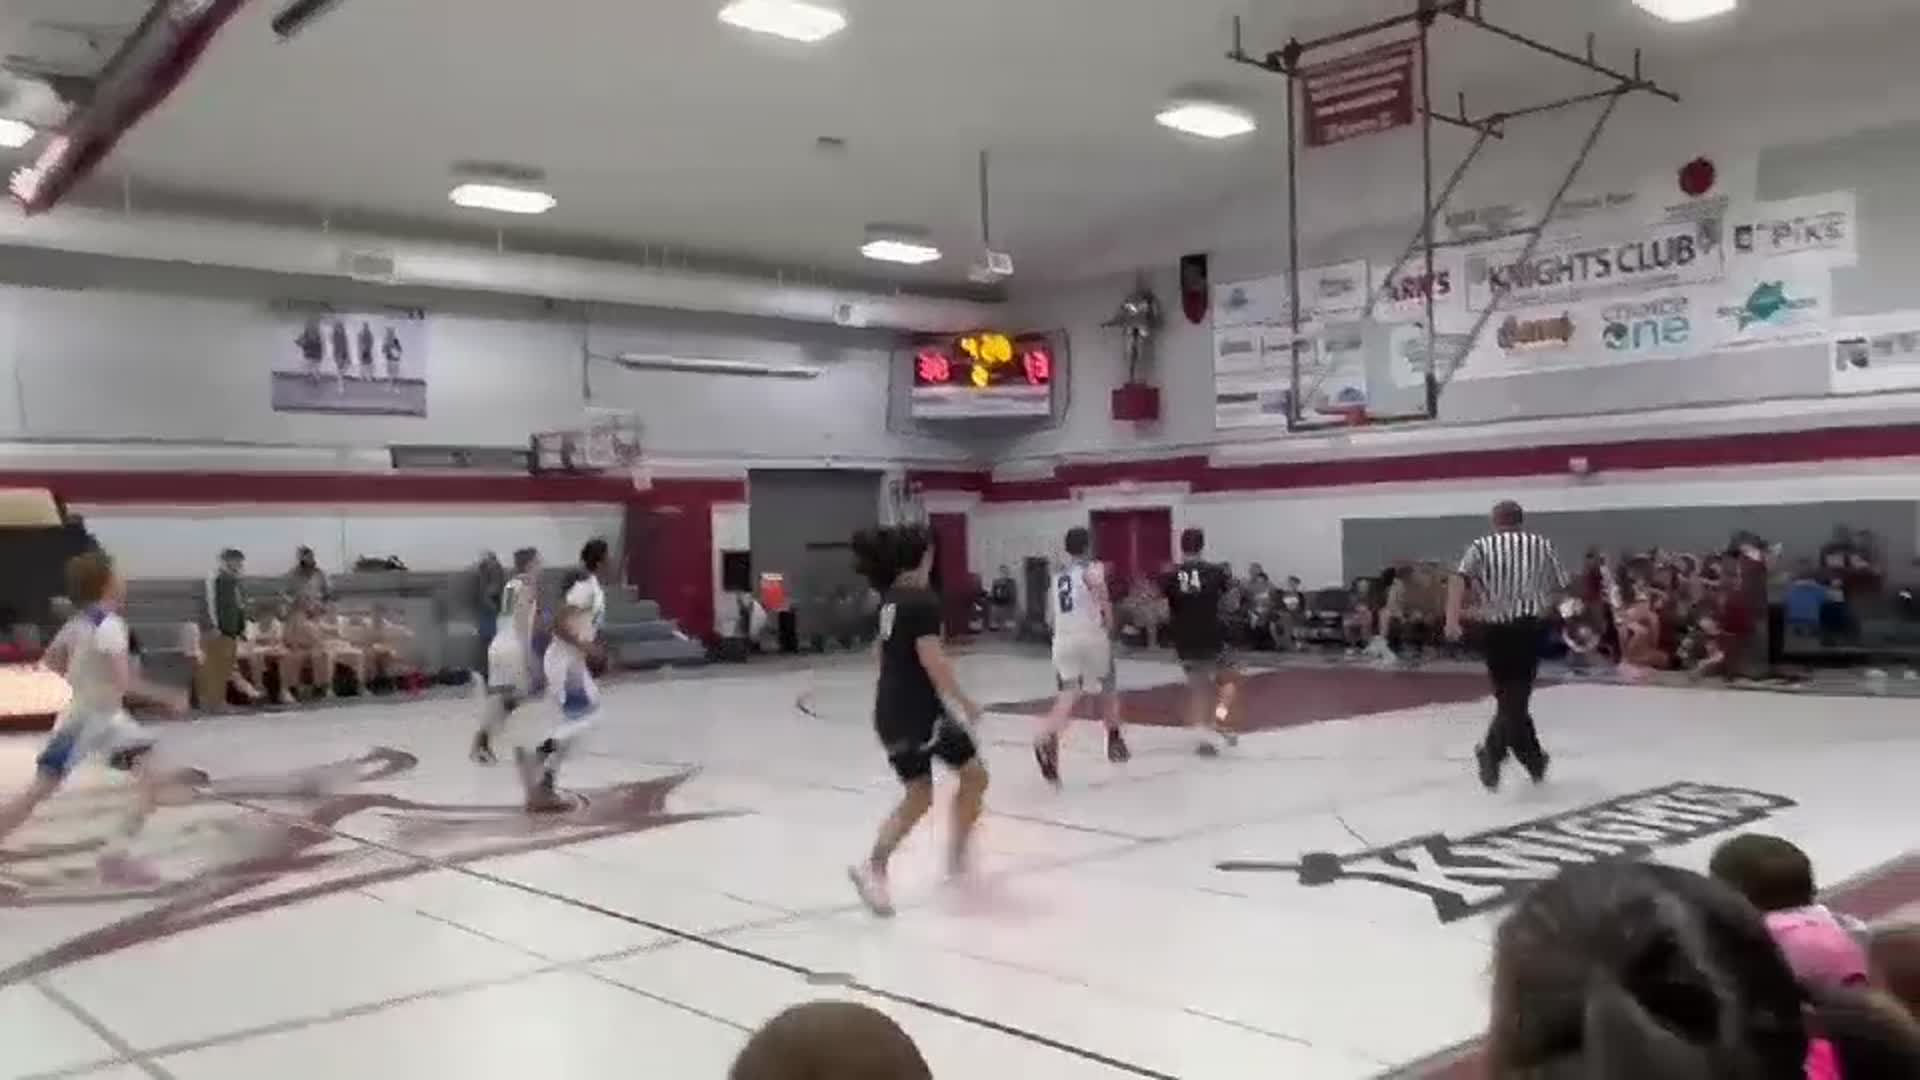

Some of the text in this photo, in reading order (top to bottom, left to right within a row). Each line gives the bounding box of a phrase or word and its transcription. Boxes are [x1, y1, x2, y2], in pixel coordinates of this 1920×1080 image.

[1489, 234, 1696, 293] KNIGHTS CLUB
[1057, 575, 1073, 613] 2
